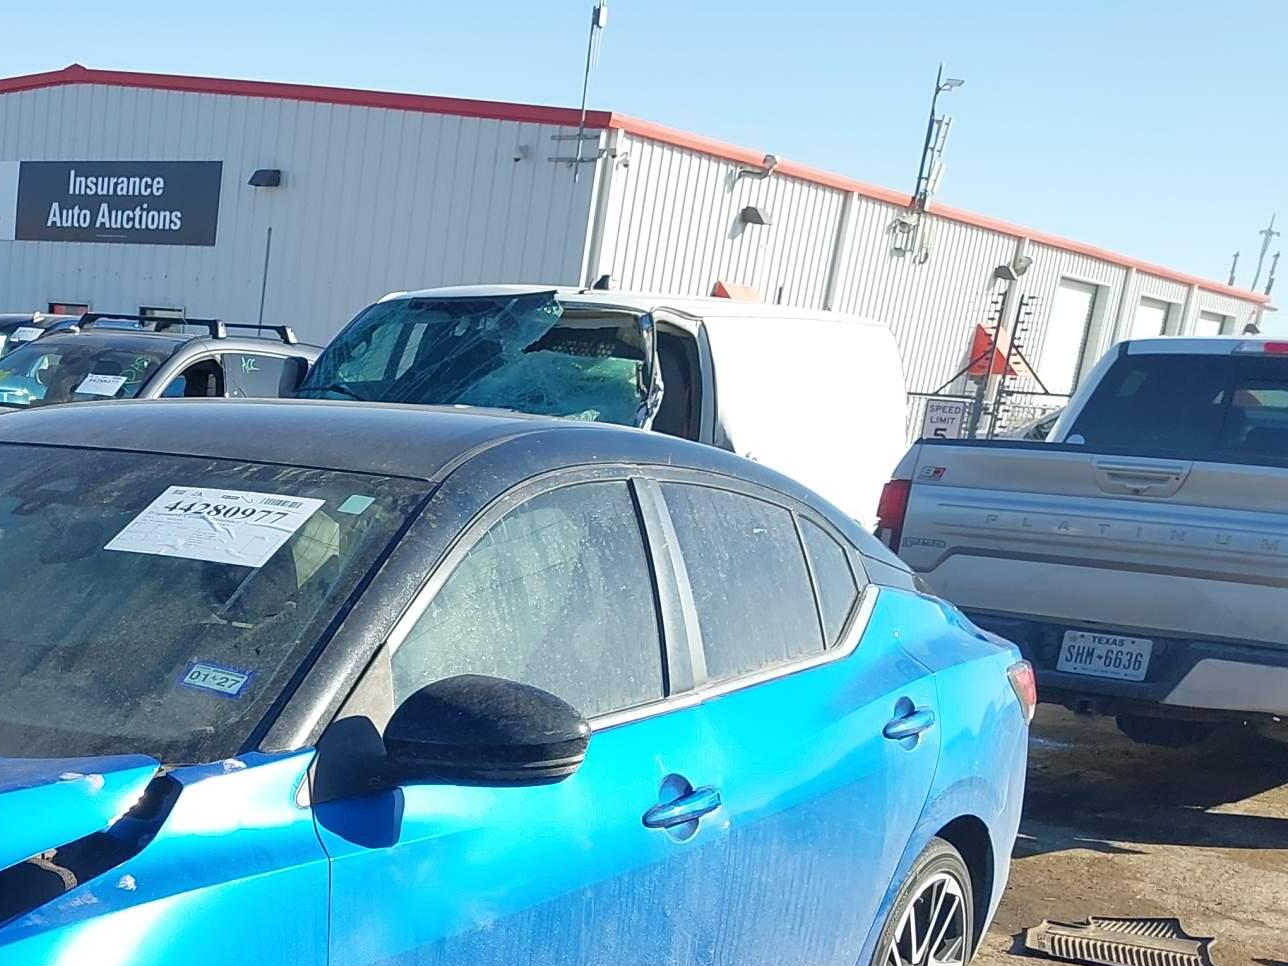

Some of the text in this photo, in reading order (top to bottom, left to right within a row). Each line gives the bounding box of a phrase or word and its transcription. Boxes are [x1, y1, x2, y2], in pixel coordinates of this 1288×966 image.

[68, 168, 166, 197] Insurance
[46, 202, 183, 231] Auto Auctions
[929, 404, 962, 414] SPEED
[929, 415, 956, 425] LIMIT
[163, 499, 290, 525] 44280977
[984, 513, 1281, 551] PLATINUM
[1091, 635, 1126, 648] TEXAS
